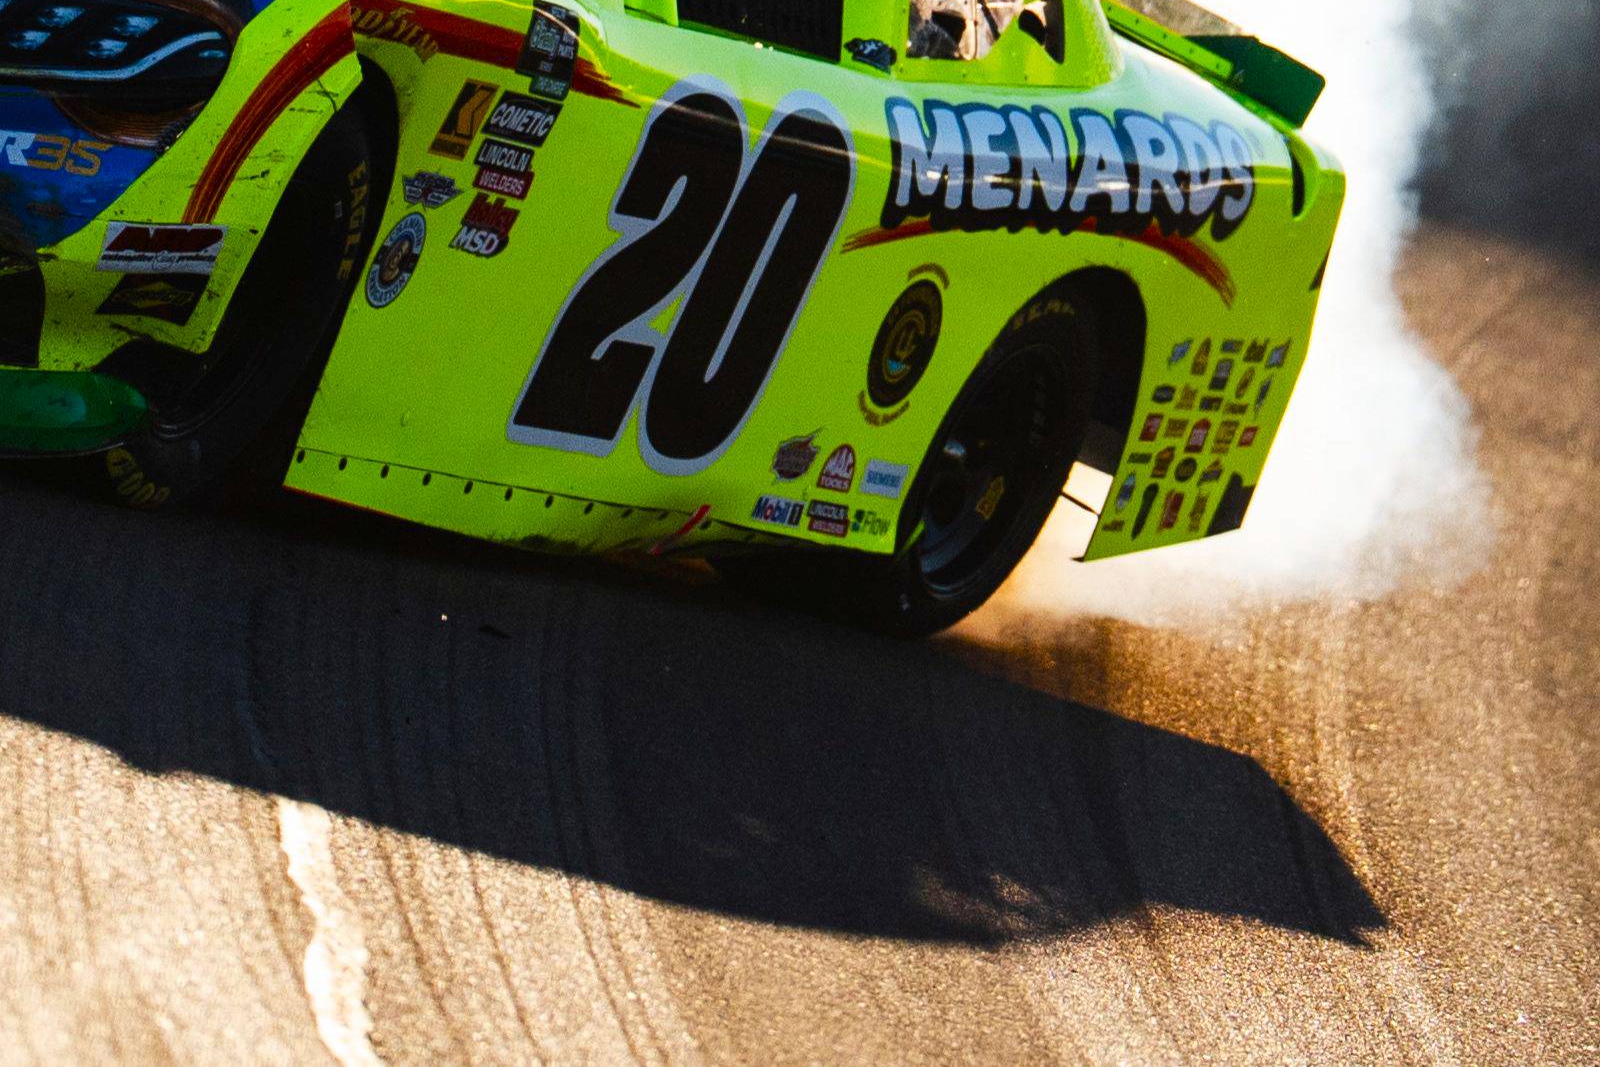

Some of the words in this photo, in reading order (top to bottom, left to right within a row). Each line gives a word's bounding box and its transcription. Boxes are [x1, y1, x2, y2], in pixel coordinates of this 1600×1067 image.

[490, 102, 554, 138] COMETIC
[477, 142, 531, 173] LINCOLN
[882, 99, 1258, 238] MENARDS
[478, 170, 526, 197] WELDERS
[452, 225, 501, 256] MSD
[507, 76, 857, 474] 20
[752, 495, 790, 525] Mobil
